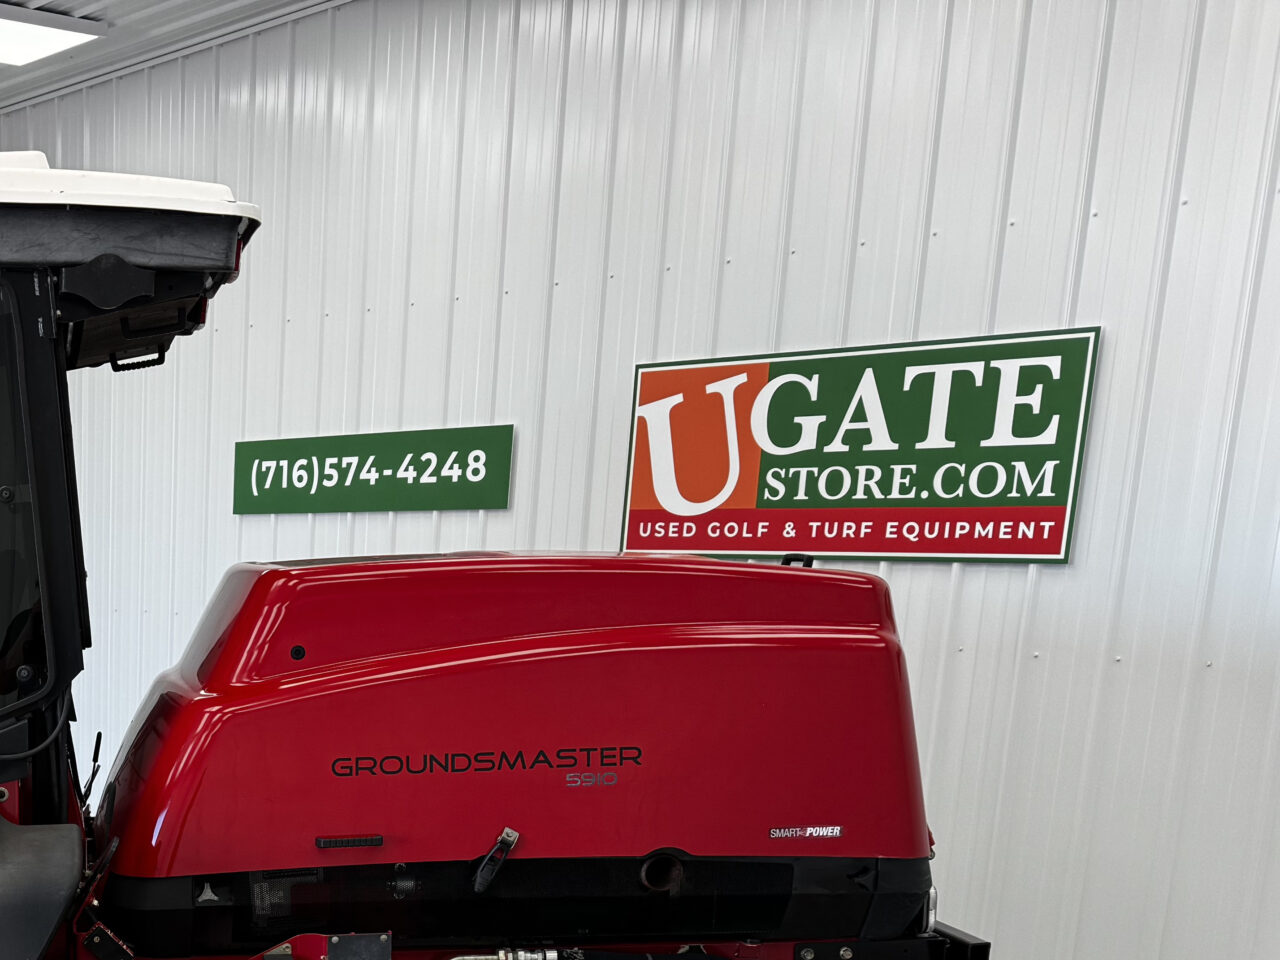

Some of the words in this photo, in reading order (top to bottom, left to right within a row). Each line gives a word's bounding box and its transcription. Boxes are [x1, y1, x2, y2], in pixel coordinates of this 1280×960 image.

[638, 355, 1062, 517] UGATE
[251, 449, 487, 496] (716)574-4248
[764, 460, 1060, 500] STORE.COM
[639, 522, 697, 538] USED
[707, 522, 770, 538] GOLF
[782, 523, 796, 538] &
[808, 521, 873, 539] TURF
[885, 521, 1056, 542] EQUIPMENT
[331, 746, 643, 777] GROUNDSMASTER
[565, 772, 618, 787] 5910
[805, 826, 841, 837] POWER
